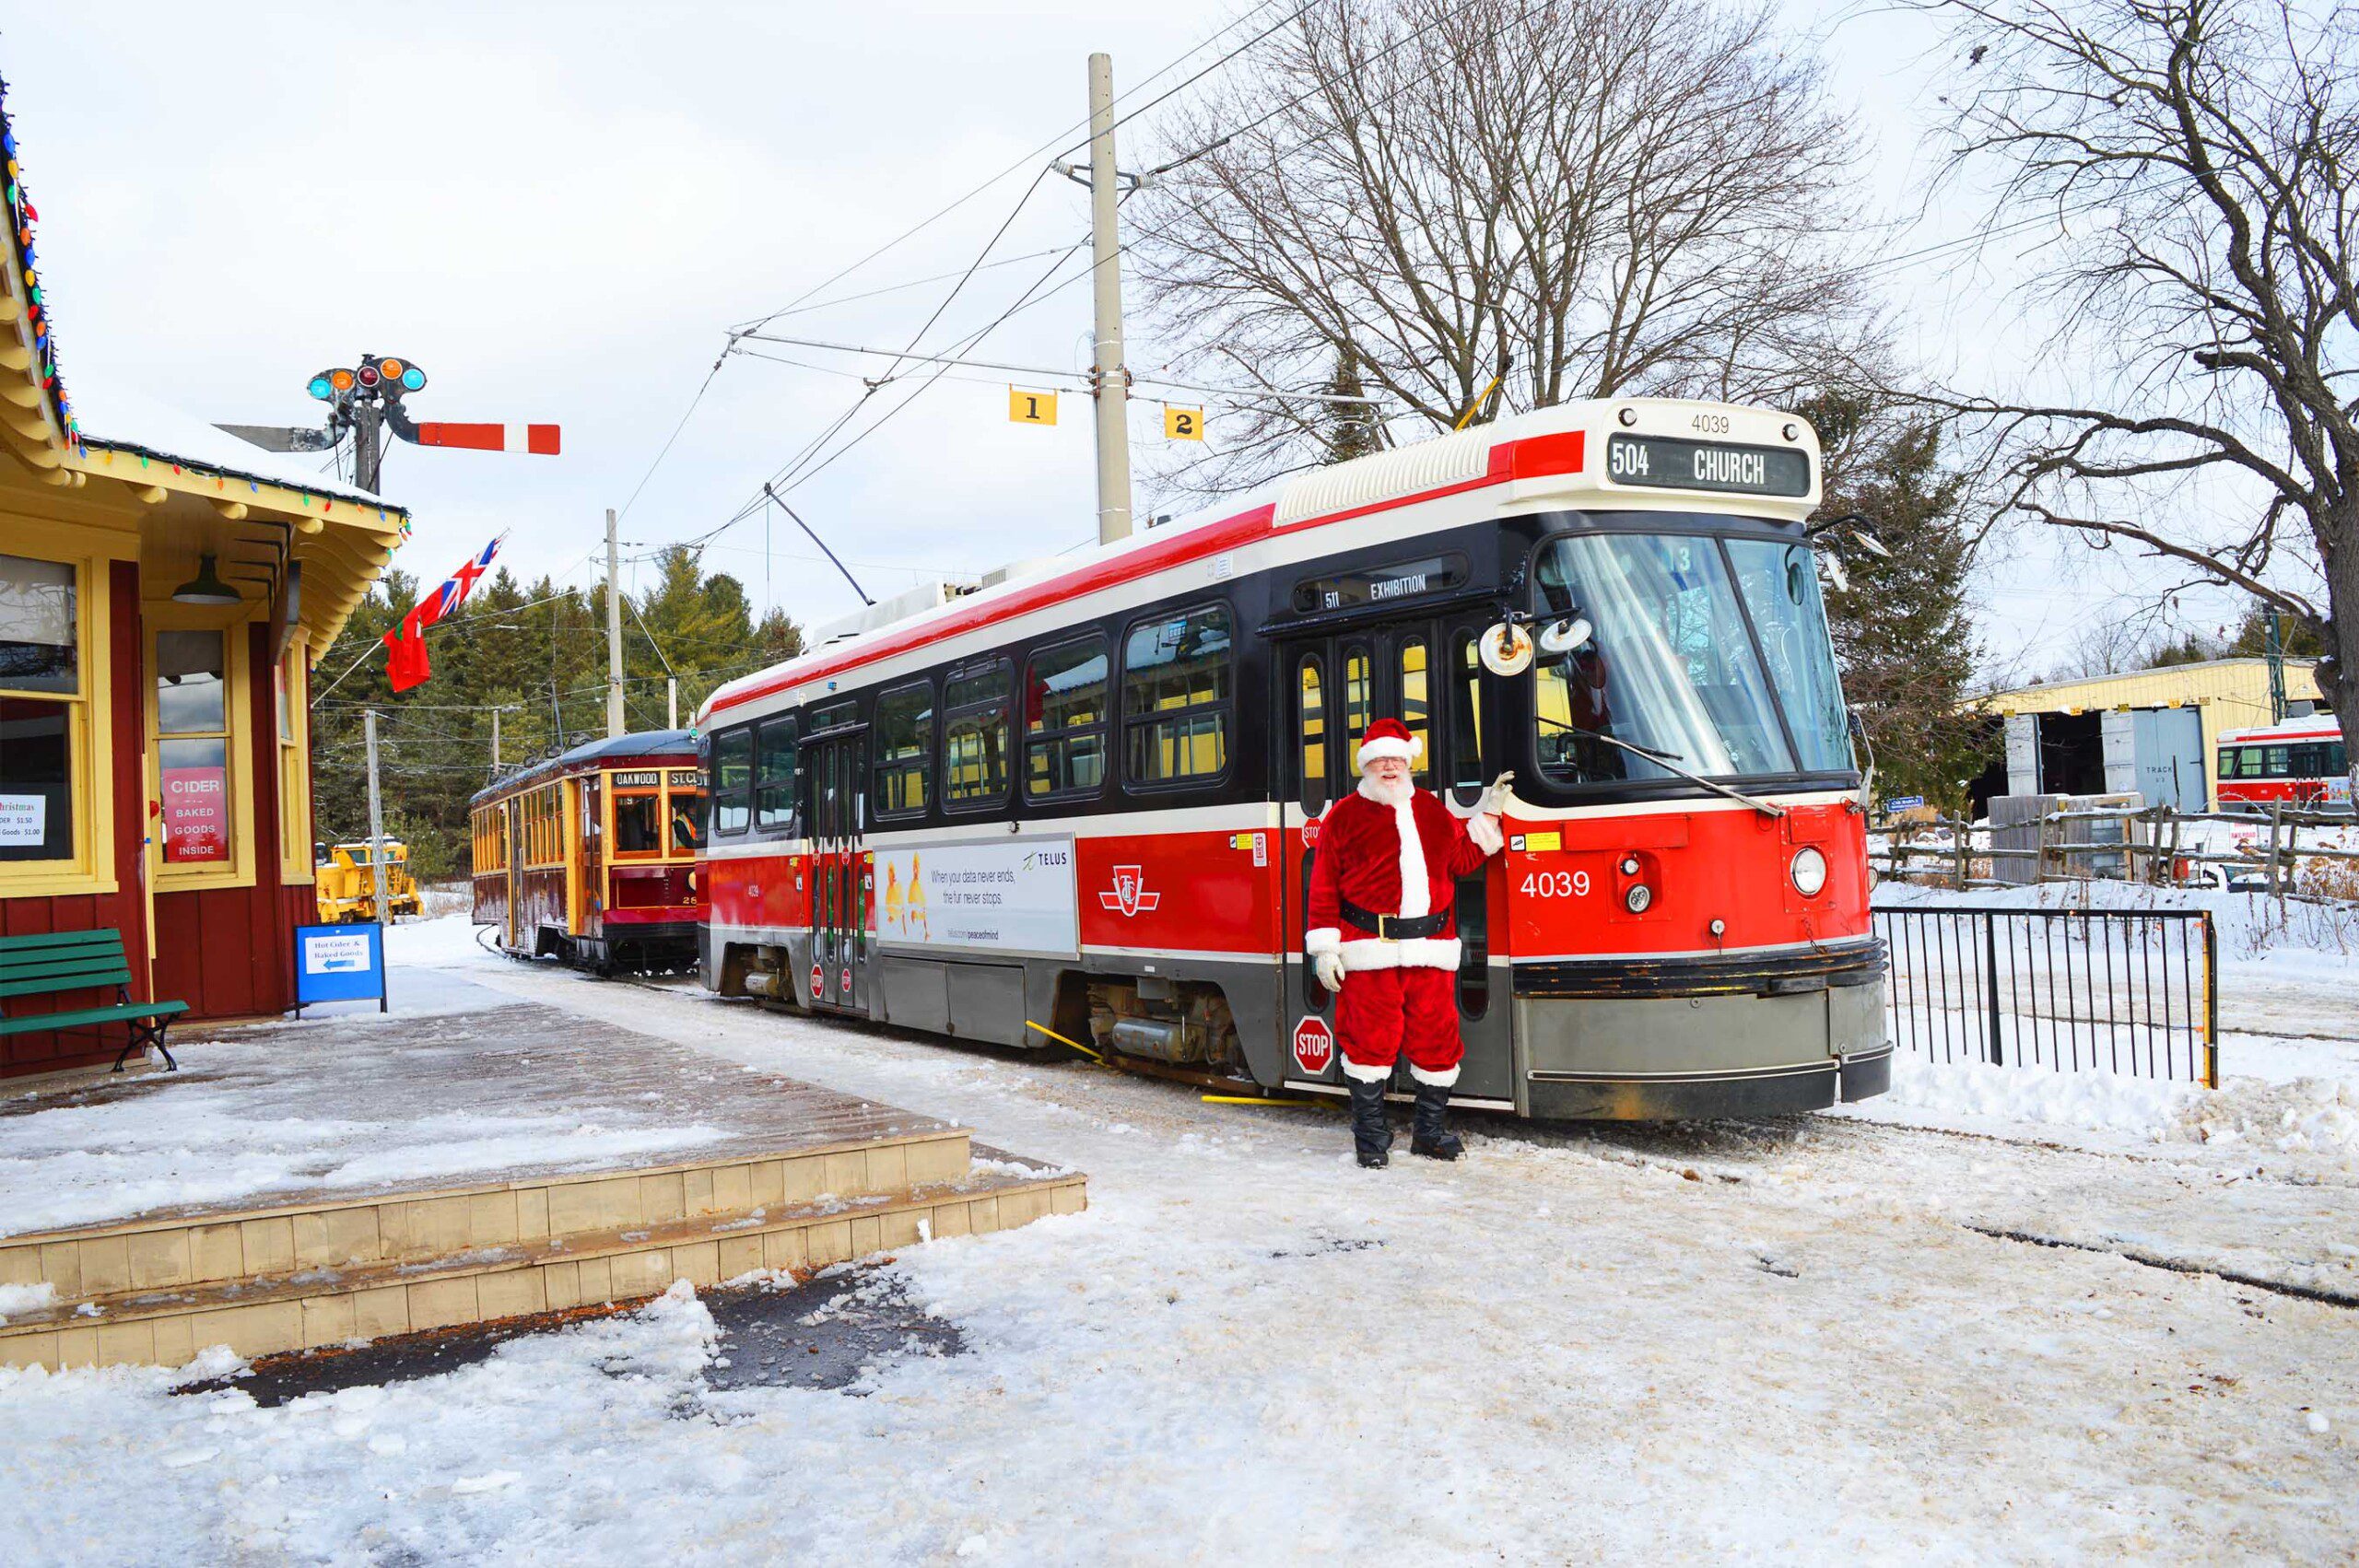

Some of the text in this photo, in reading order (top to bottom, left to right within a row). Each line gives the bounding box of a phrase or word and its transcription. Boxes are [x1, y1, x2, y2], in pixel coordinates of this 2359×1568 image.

[1026, 396, 1040, 420] 1
[1176, 414, 1192, 435] 2
[1691, 414, 1730, 434] 4039
[1613, 442, 1765, 485] 504 CHURCH
[1325, 573, 1427, 608] 511 EXHIBITION
[2146, 766, 2173, 774] TRACK
[170, 779, 220, 793] CIDER
[616, 772, 657, 785] OAKWOOD
[175, 807, 215, 818] BAKED
[174, 825, 216, 835] GOODS
[1304, 825, 1320, 838] STO
[179, 845, 215, 856] INSIDE
[1039, 852, 1067, 866] TELUS
[931, 867, 1015, 886] When your data never ends,
[1520, 871, 1590, 897] 4039
[943, 892, 953, 905] the
[963, 894, 980, 905] never
[982, 891, 1003, 908] stops.
[330, 940, 350, 948] Cider
[1298, 1033, 1329, 1058] STOP
